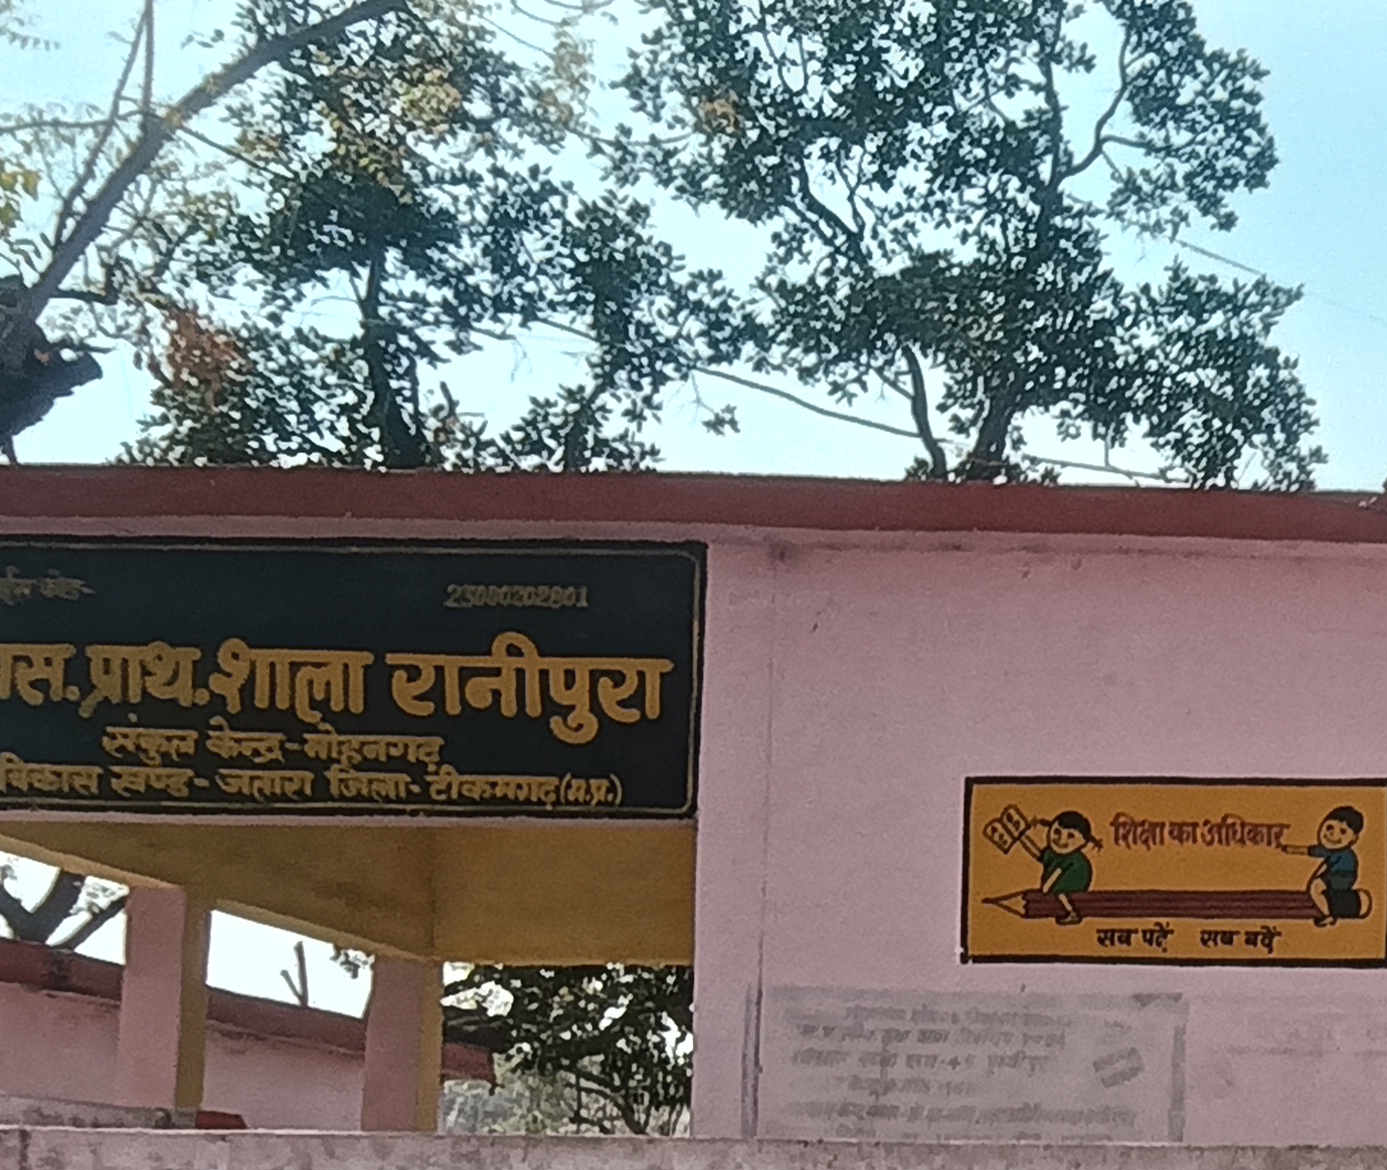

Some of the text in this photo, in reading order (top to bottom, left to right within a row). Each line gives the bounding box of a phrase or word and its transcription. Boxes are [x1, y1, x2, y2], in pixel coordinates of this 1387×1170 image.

[208, 638, 374, 724] शाला
[385, 631, 674, 744] रानीपुरा
[1110, 812, 1291, 850] शिक्षा का अधिकार
